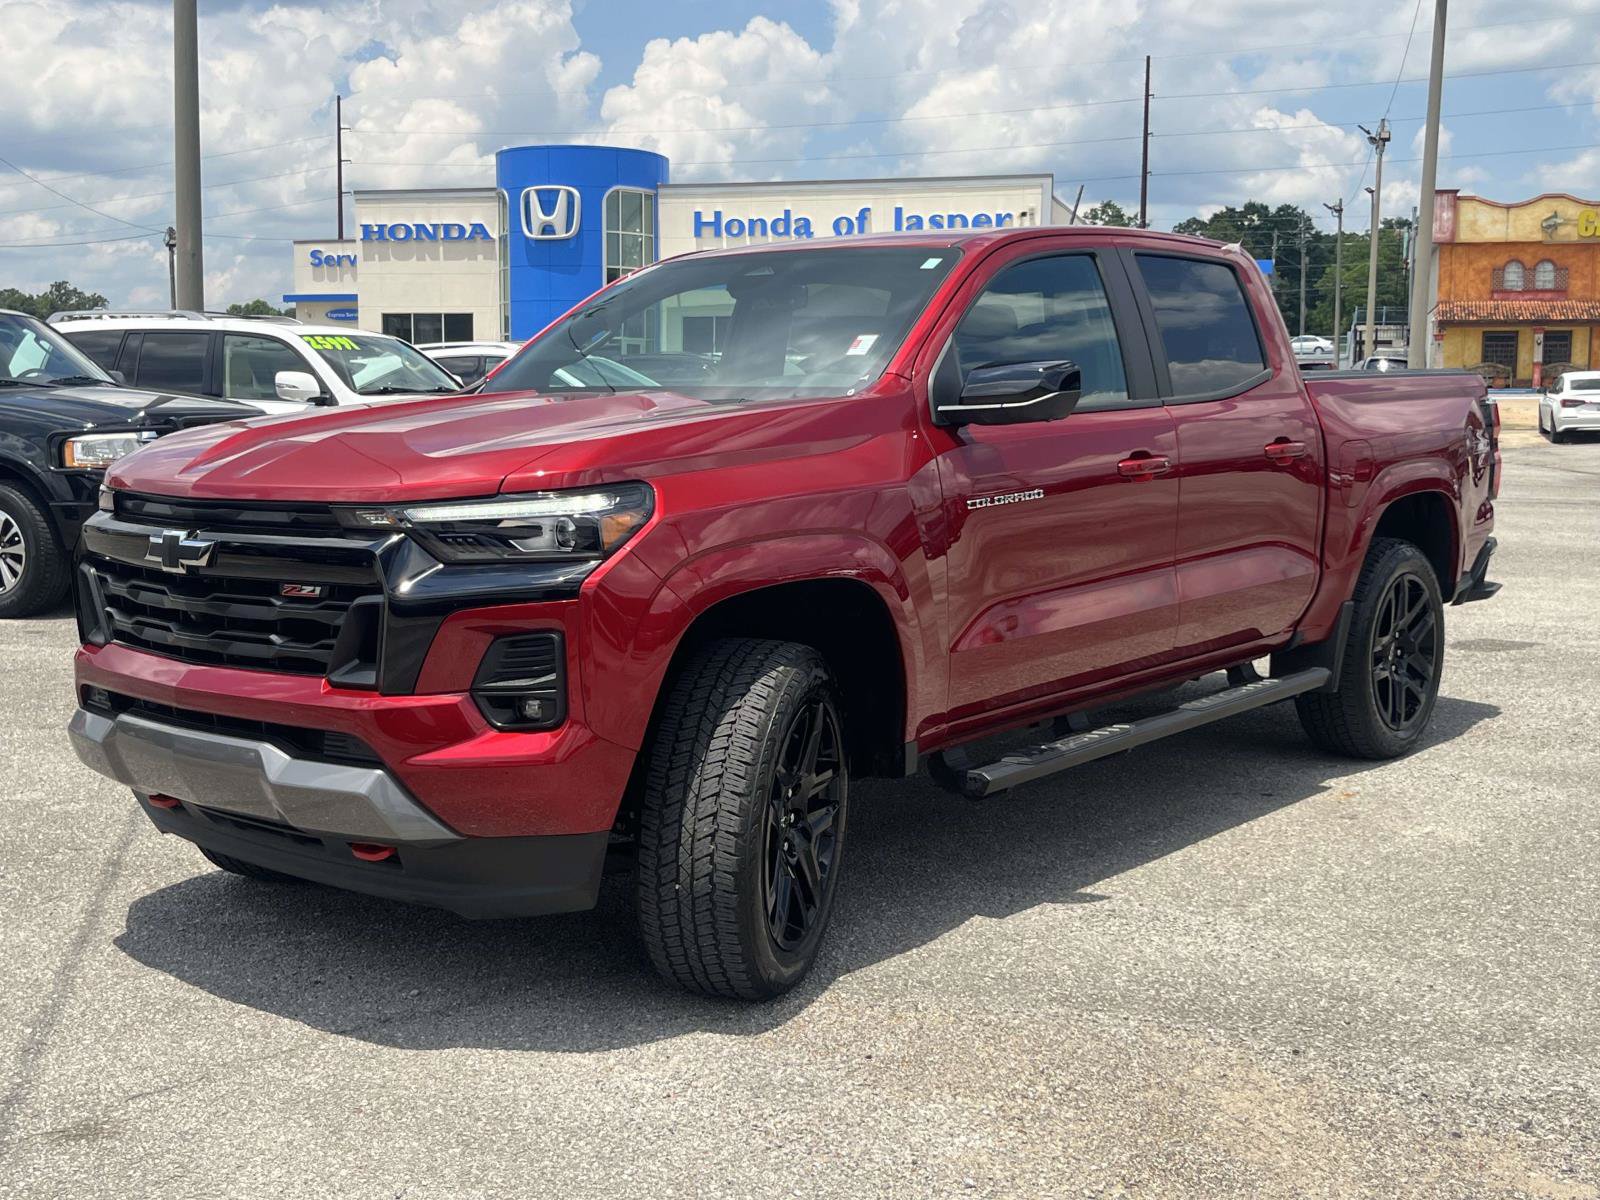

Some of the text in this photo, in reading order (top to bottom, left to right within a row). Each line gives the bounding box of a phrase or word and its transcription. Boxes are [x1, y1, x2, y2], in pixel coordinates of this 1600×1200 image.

[360, 223, 495, 241] HONDA
[694, 209, 814, 238] Honda
[832, 207, 871, 236] of
[966, 488, 1044, 510] COLORADO
[281, 584, 322, 598] Z71
